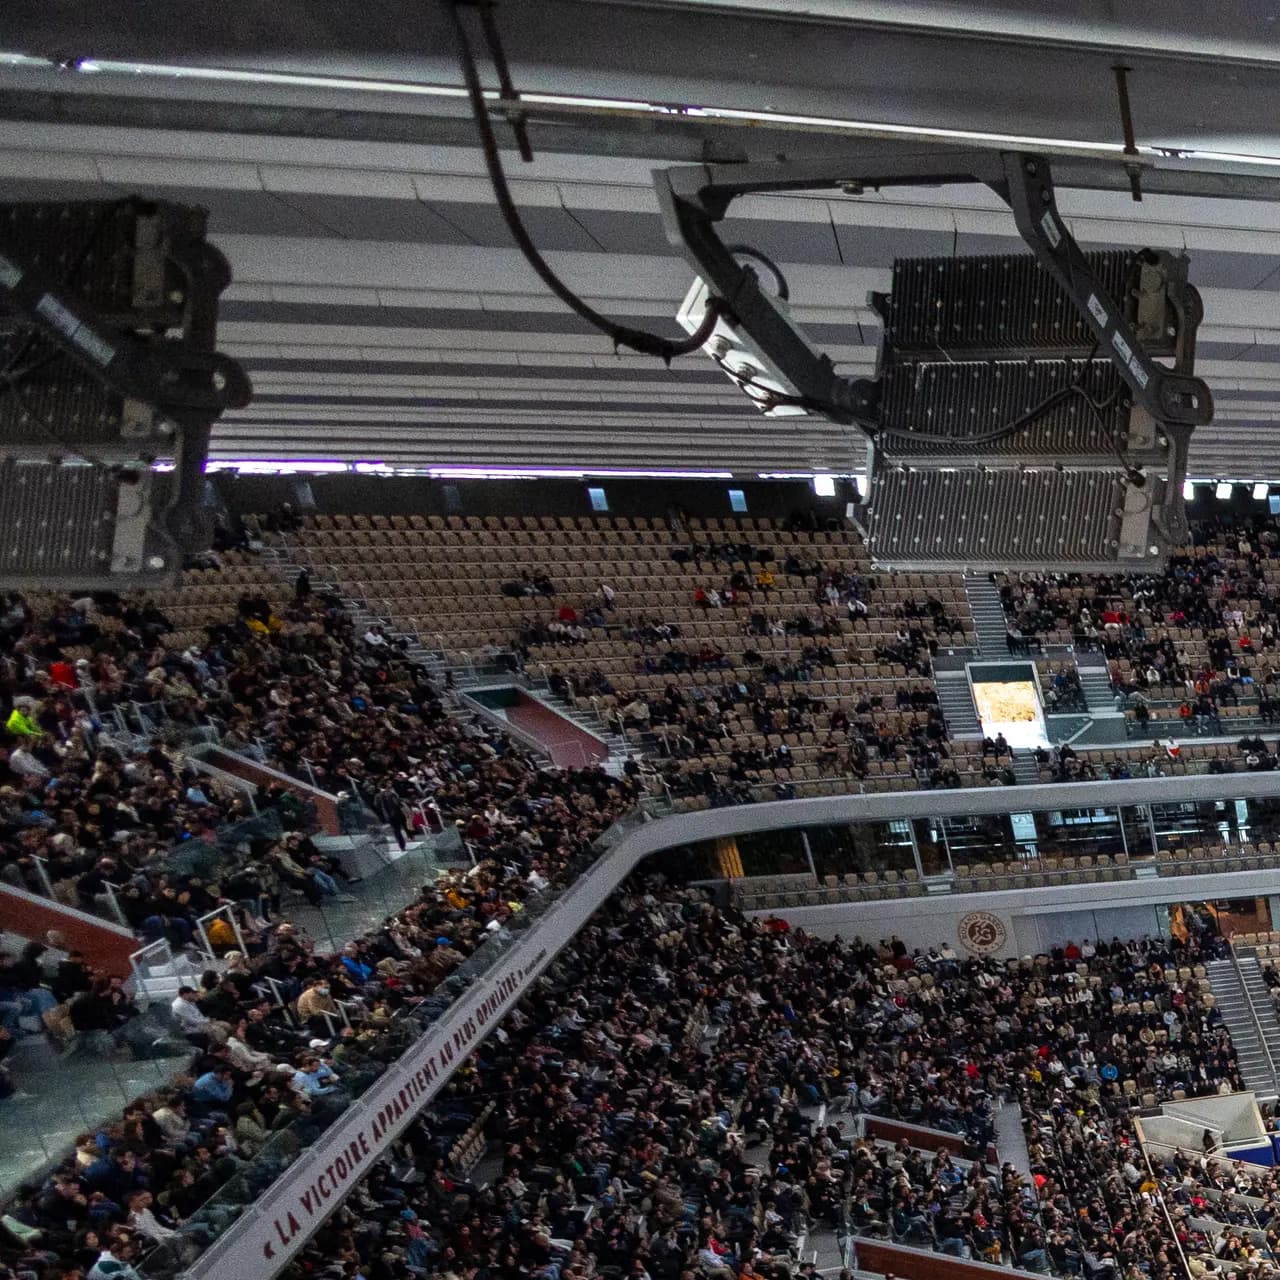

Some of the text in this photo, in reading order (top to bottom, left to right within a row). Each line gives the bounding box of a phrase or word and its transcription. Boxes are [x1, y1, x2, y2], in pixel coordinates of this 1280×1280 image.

[273, 1211, 301, 1246] LA
[300, 1131, 370, 1215] VICTOIRE
[373, 1059, 438, 1145] APPARTIENT
[440, 1045, 453, 1070] AU
[454, 1016, 477, 1054] PLUS
